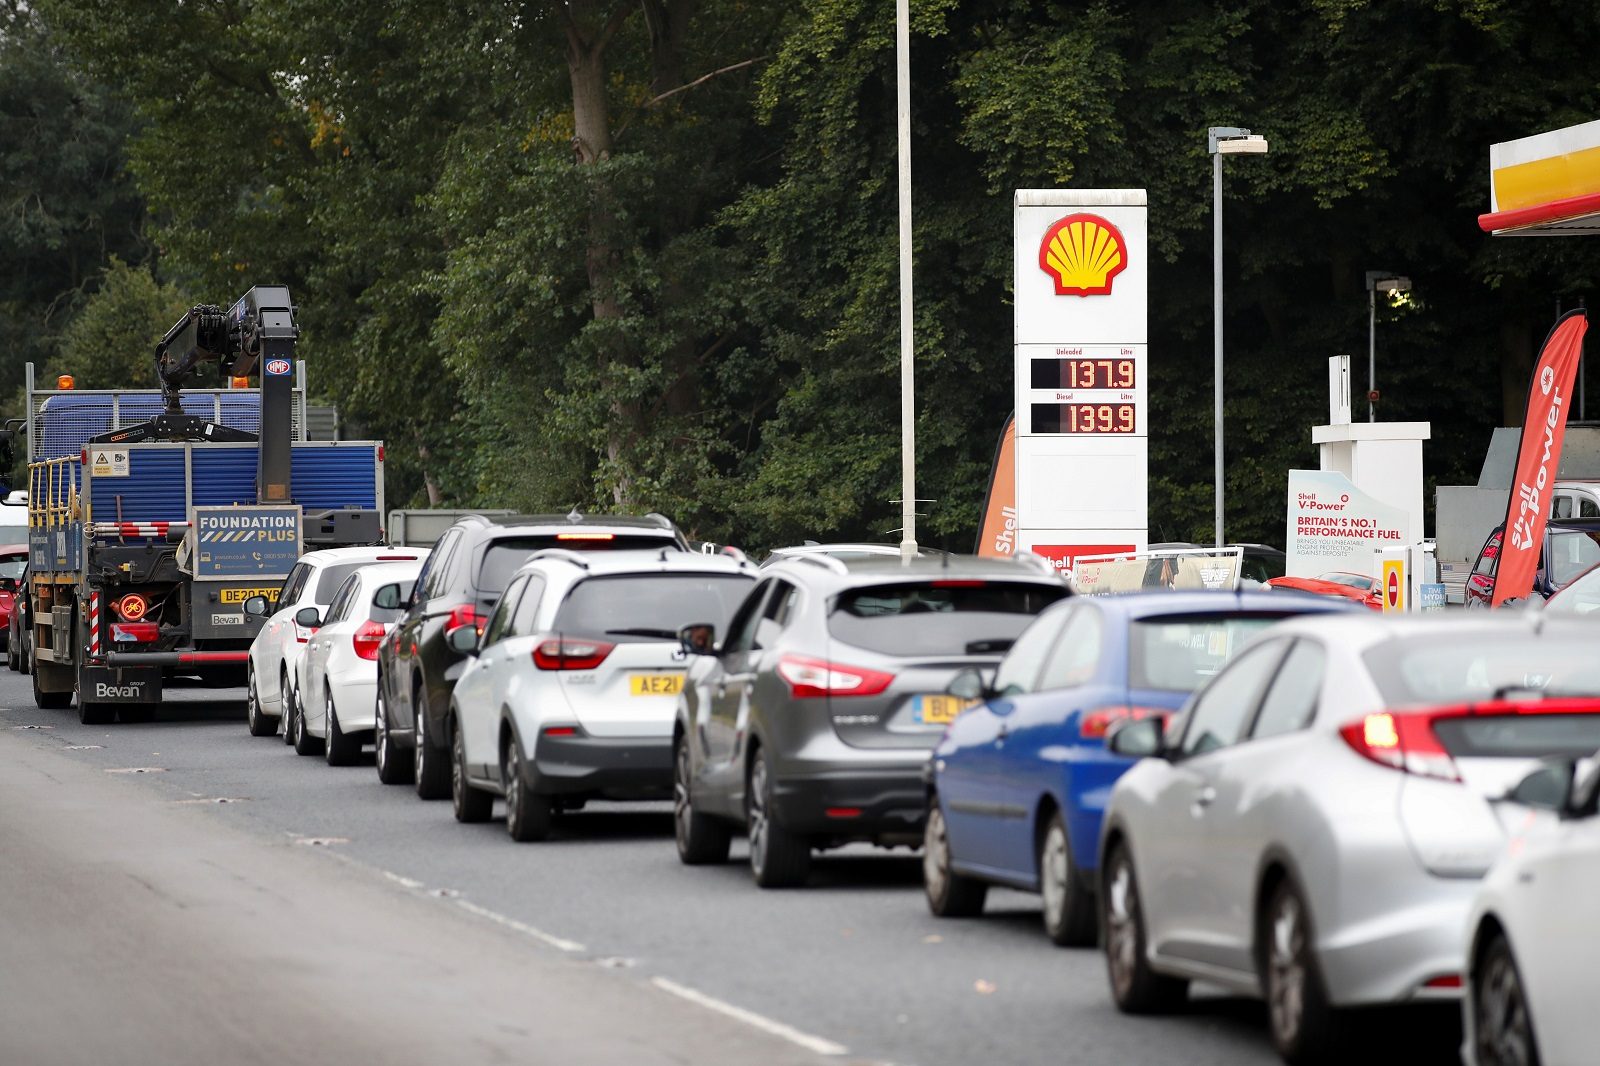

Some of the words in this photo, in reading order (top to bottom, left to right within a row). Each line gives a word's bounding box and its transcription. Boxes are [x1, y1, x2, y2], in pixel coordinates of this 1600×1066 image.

[269, 361, 288, 374] HMF
[1070, 361, 1134, 388] 137.9
[1070, 405, 1134, 432] 139.9
[1520, 386, 1563, 551] V-Power
[1298, 493, 1316, 501] Shell
[1298, 501, 1345, 511] V-Power
[1297, 516, 1348, 527] BRITAIN'S
[1350, 518, 1377, 528] NO.1
[1511, 482, 1532, 549] Shell
[200, 516, 295, 529] FOUNDATION
[257, 530, 296, 542] PLUS
[995, 505, 1016, 554] Shell
[1297, 527, 1375, 539] PERFORMANCE
[1377, 530, 1401, 540] FUEL
[1041, 556, 1071, 568] hell
[213, 615, 240, 625] Bevan
[96, 683, 140, 697] Bevan
[641, 677, 678, 693] AE21
